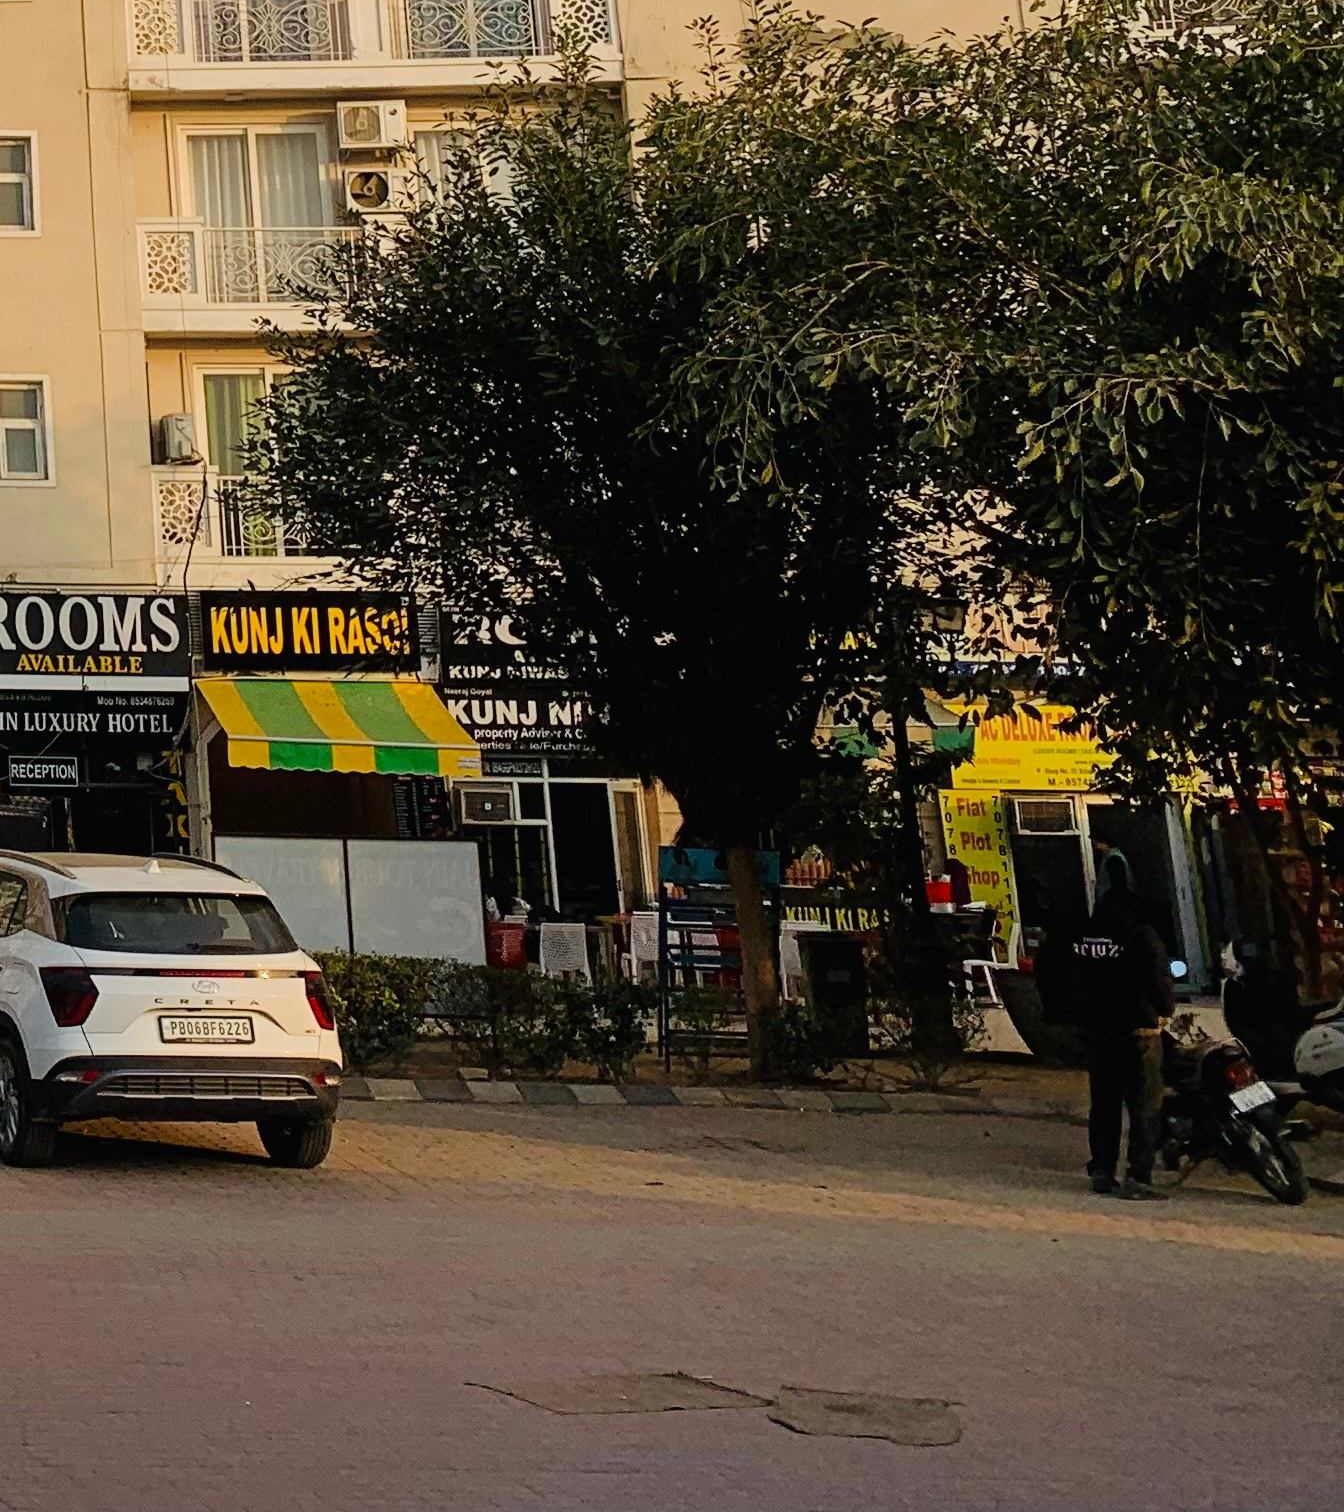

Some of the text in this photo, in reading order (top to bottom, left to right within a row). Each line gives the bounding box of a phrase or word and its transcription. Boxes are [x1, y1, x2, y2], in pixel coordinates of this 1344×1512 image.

[210, 607, 284, 654] KUNJ
[291, 607, 321, 655] KI
[16, 654, 143, 674] AVAILABLE
[23, 712, 100, 732] LUXURY
[108, 713, 173, 733] HOTEL
[447, 699, 538, 726] KUNJ
[474, 728, 518, 740] property
[11, 763, 76, 779] RECEPTION
[956, 798, 987, 817] Flat
[960, 831, 993, 852] Plot
[835, 907, 853, 931] KI
[154, 998, 260, 1006] CRETA
[170, 1020, 249, 1036] PB06BF6226
